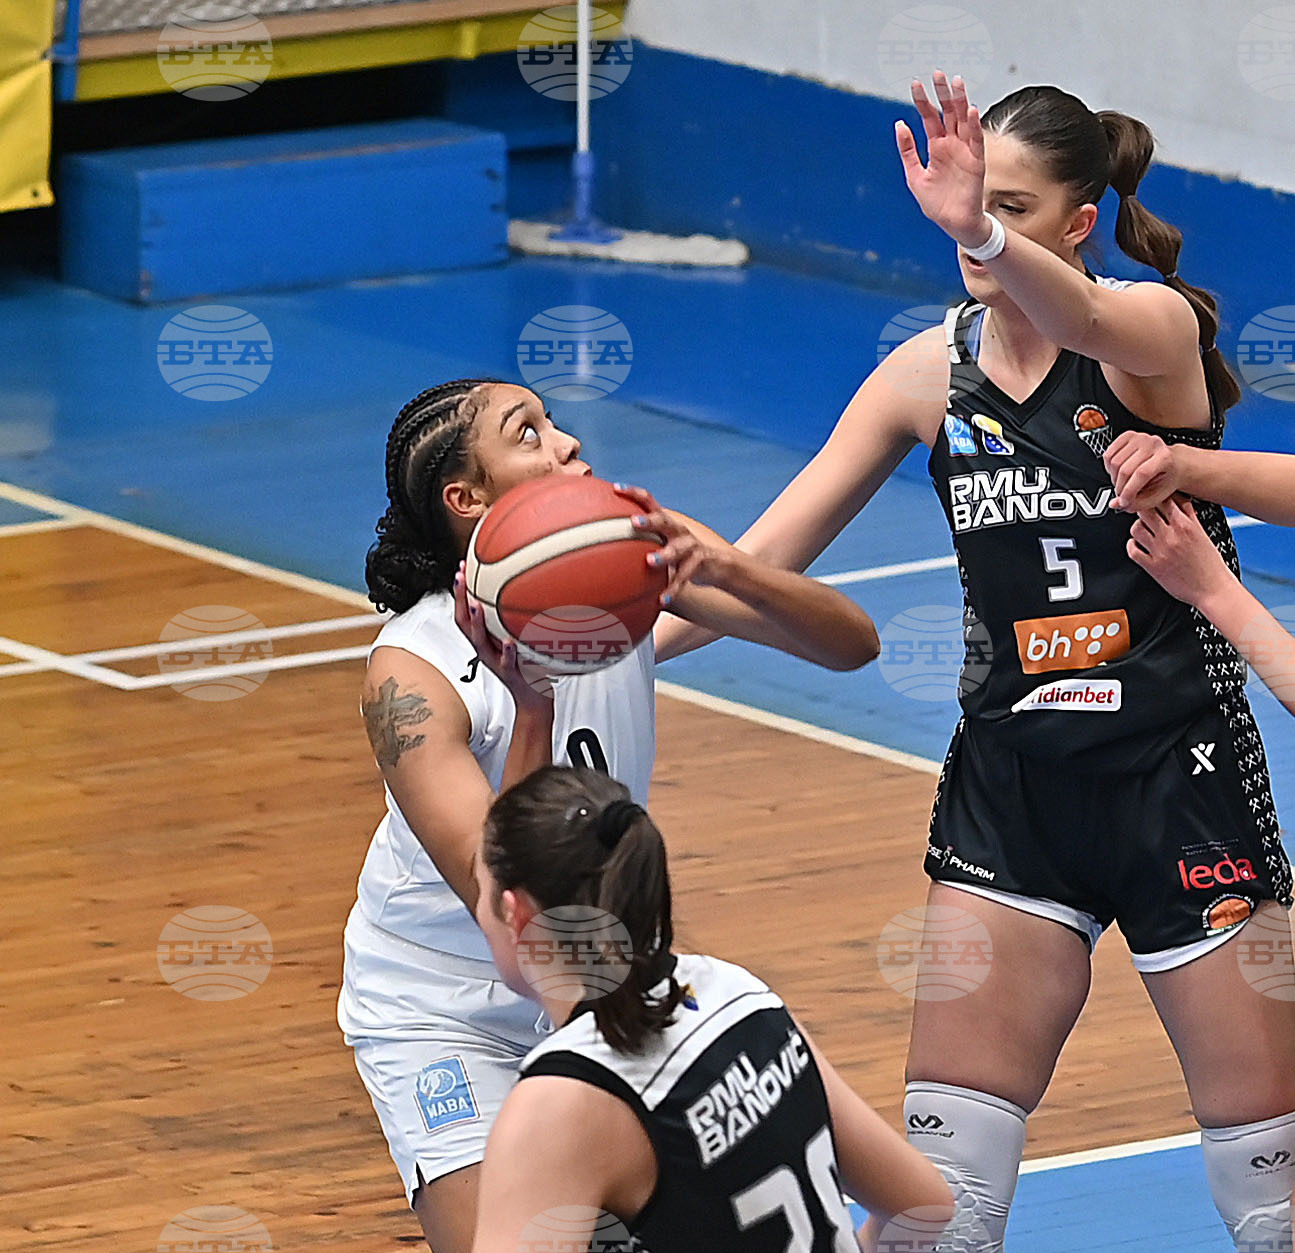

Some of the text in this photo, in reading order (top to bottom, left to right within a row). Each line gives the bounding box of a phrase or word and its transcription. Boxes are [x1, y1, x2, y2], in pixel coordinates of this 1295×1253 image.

[949, 467, 1050, 505] RMU
[951, 486, 1114, 534] BANOV
[1039, 537, 1083, 602] 5
[950, 855, 995, 881] PHARM
[1177, 852, 1257, 890] leda
[685, 1052, 758, 1136] RMU
